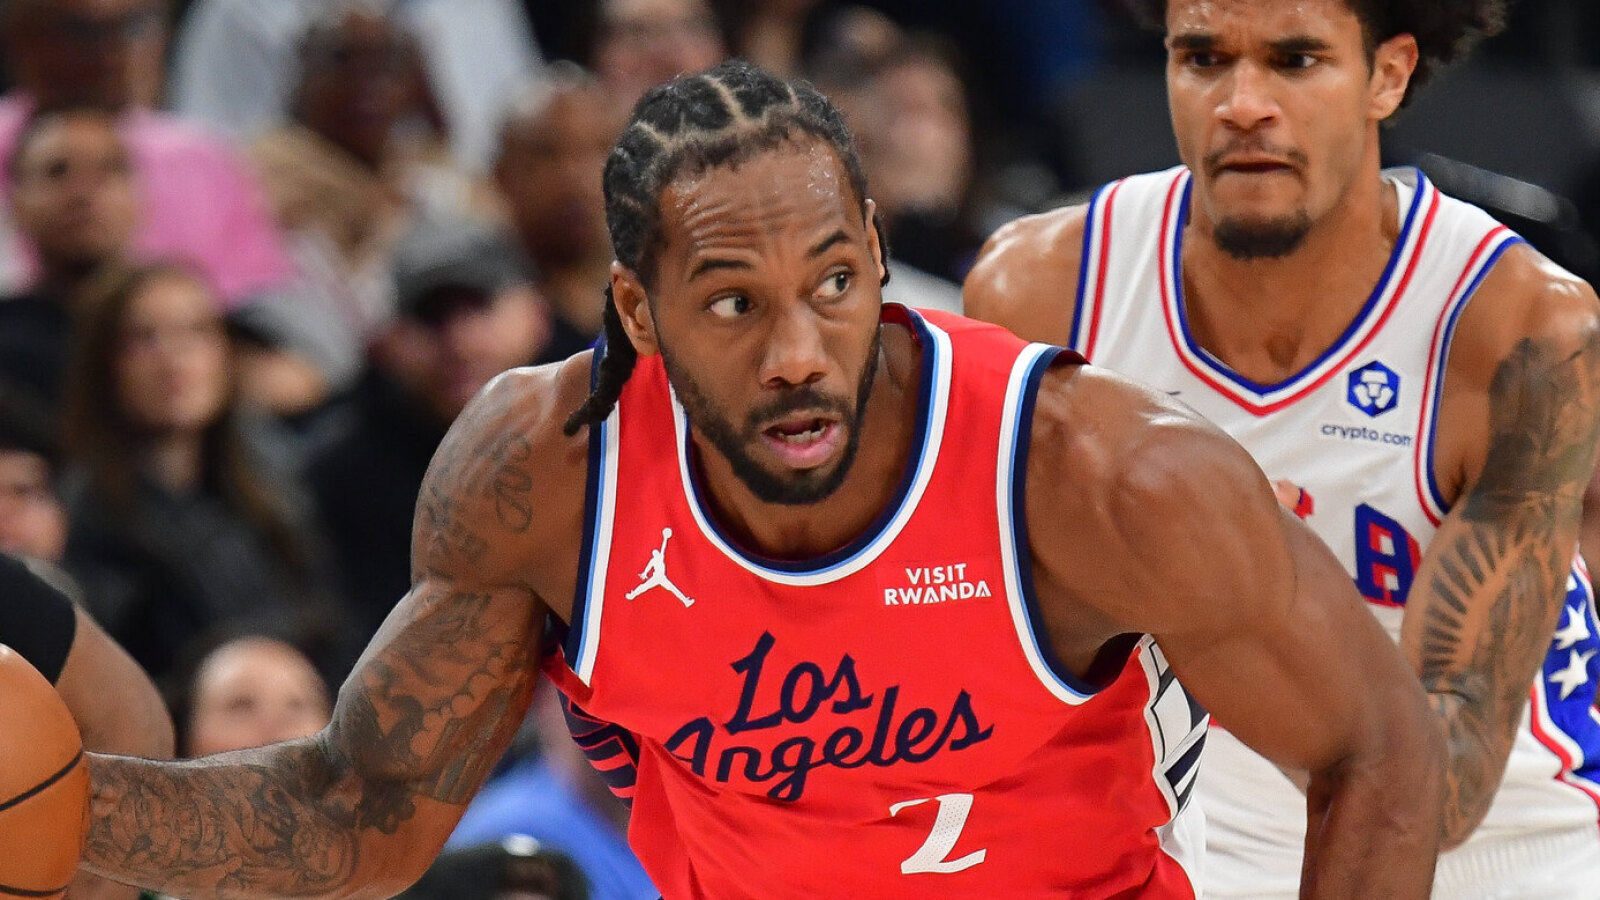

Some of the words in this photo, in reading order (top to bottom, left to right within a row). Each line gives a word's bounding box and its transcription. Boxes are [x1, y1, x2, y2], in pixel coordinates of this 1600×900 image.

[884, 580, 992, 606] RWANDA
[905, 563, 967, 584] VISIT
[724, 630, 874, 735] Los
[664, 686, 995, 801] Angeles
[889, 793, 987, 875] 2
